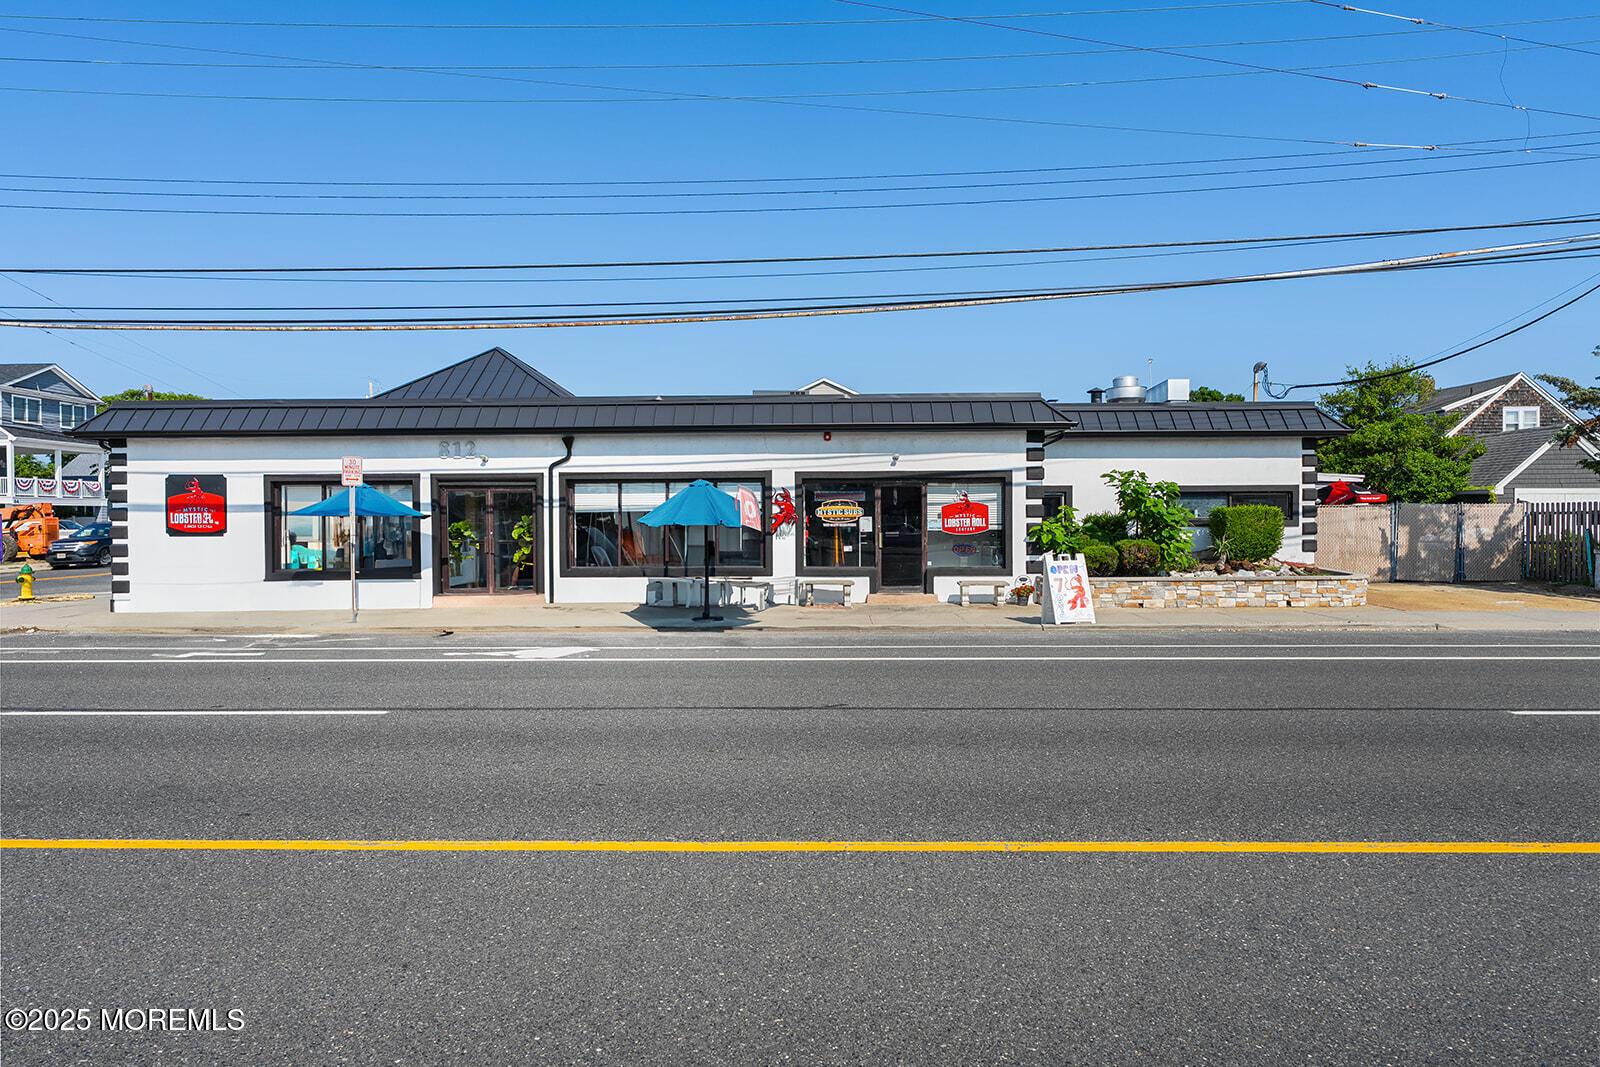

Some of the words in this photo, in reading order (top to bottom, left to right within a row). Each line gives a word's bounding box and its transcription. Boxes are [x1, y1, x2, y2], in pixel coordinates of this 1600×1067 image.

[439, 440, 476, 459] 812
[944, 518, 971, 528] LOBSTER
[972, 518, 987, 527] ROLL
[1050, 565, 1078, 574] OPEN
